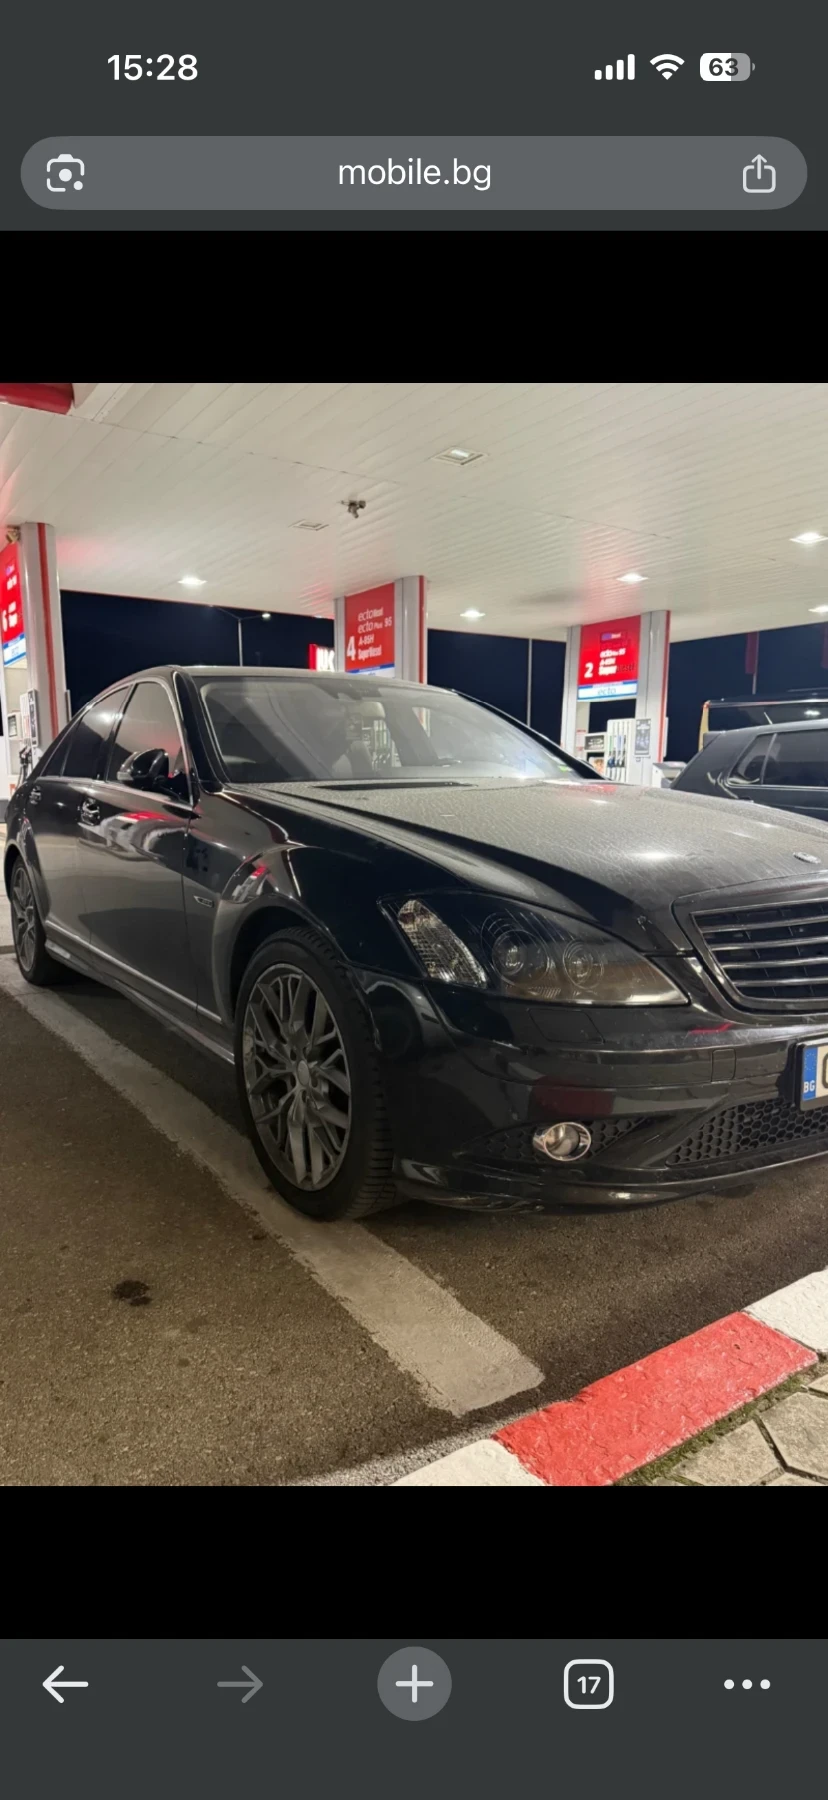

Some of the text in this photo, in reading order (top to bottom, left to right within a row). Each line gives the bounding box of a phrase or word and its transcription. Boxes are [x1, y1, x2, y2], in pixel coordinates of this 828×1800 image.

[346, 635, 357, 661] 4
[584, 662, 594, 679] 2
[804, 1080, 815, 1093] BG
